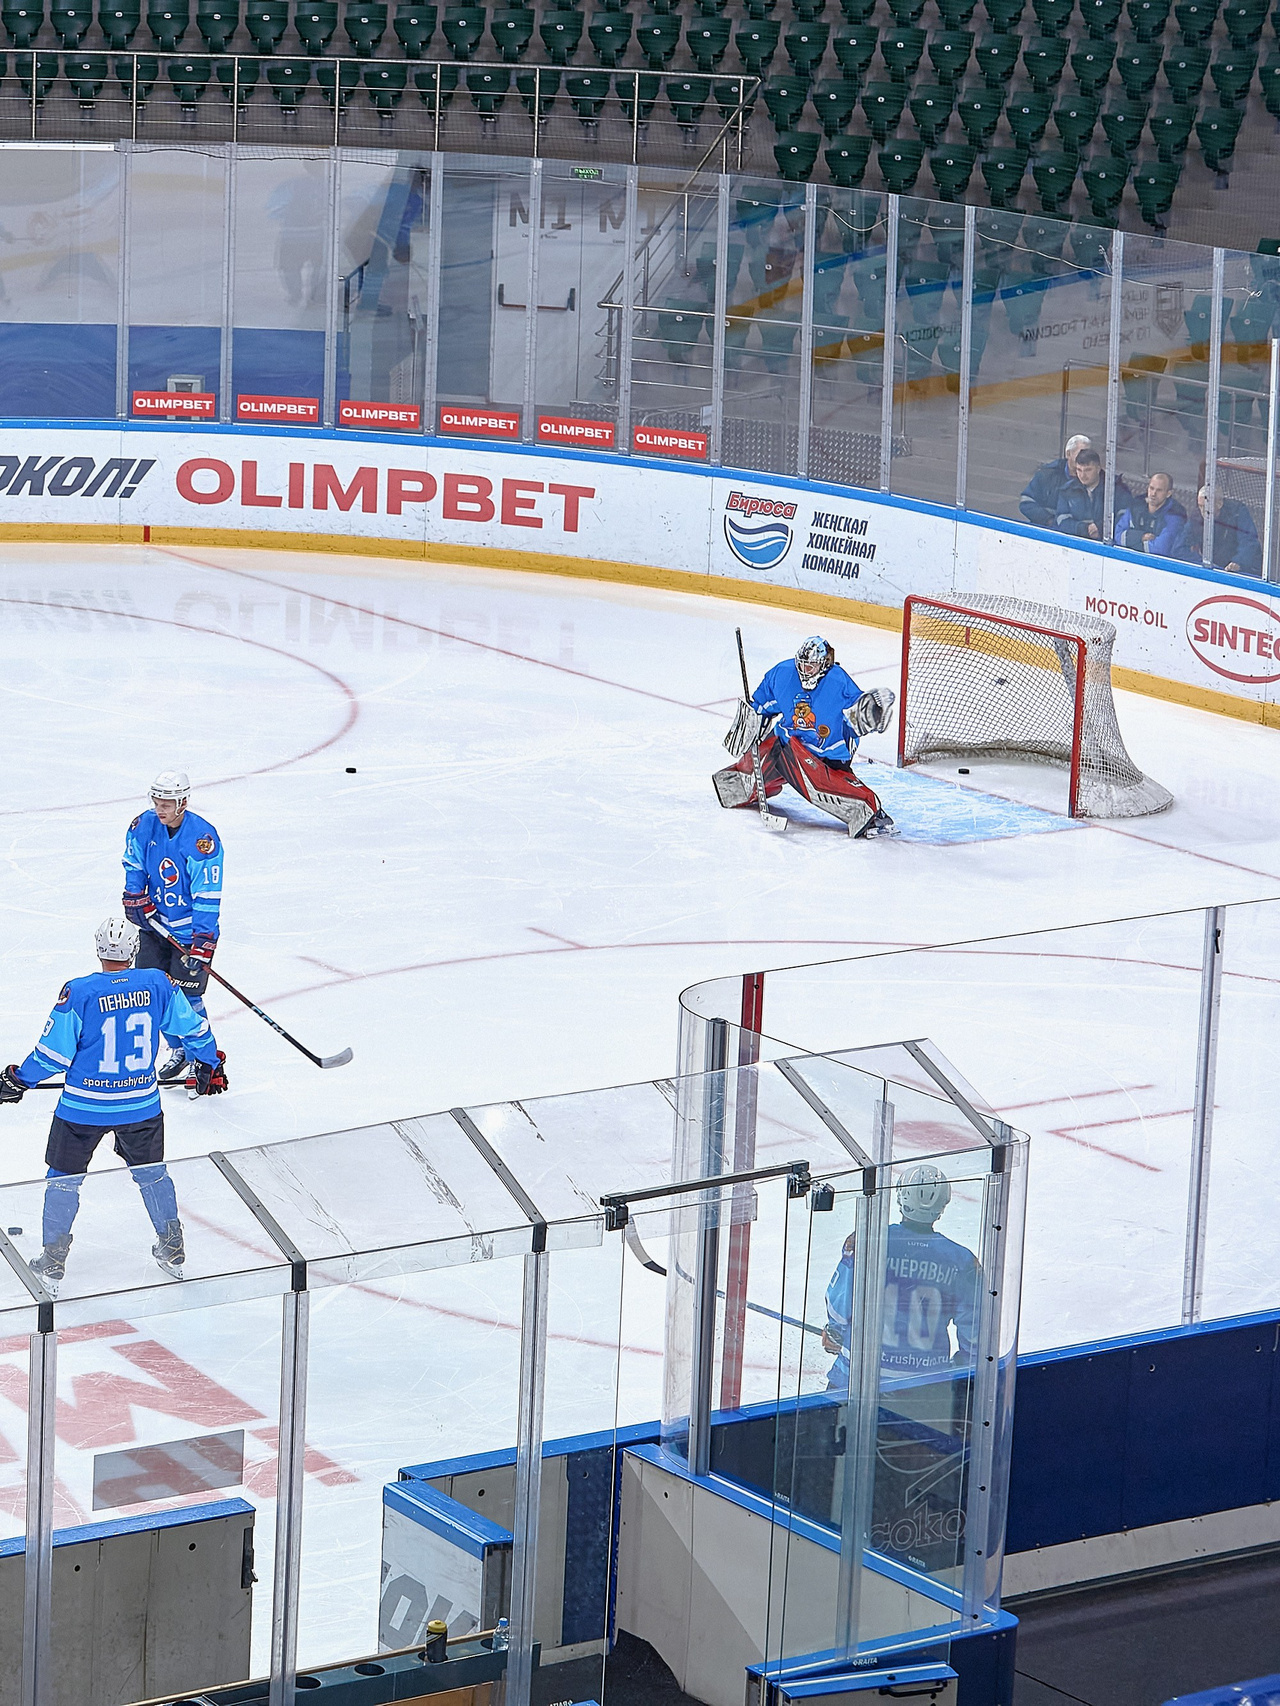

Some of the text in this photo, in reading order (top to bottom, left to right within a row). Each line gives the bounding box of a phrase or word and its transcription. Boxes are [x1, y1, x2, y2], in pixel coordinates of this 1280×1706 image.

[135, 398, 213, 410] OLIMPBET
[239, 402, 317, 415] OLIMPBET
[342, 407, 417, 422] OLIMPBET
[442, 414, 517, 431] OLIMPBET
[540, 422, 612, 440] OLIMPBET
[636, 433, 705, 451] OLIMPBET
[176, 457, 596, 533] OLIMPBET
[725, 491, 798, 520] Бирюса
[811, 511, 869, 536] ЖЕНСКАЯ
[806, 532, 877, 560] ХОККЕЙНАЯ
[802, 553, 860, 579] КОМАНДА
[1085, 596, 1168, 629] MOTOR OIL
[203, 866, 220, 885] 18
[173, 978, 200, 990] AUER
[98, 990, 151, 1012] ПЕНЬКОВ
[98, 1011, 153, 1074] 13
